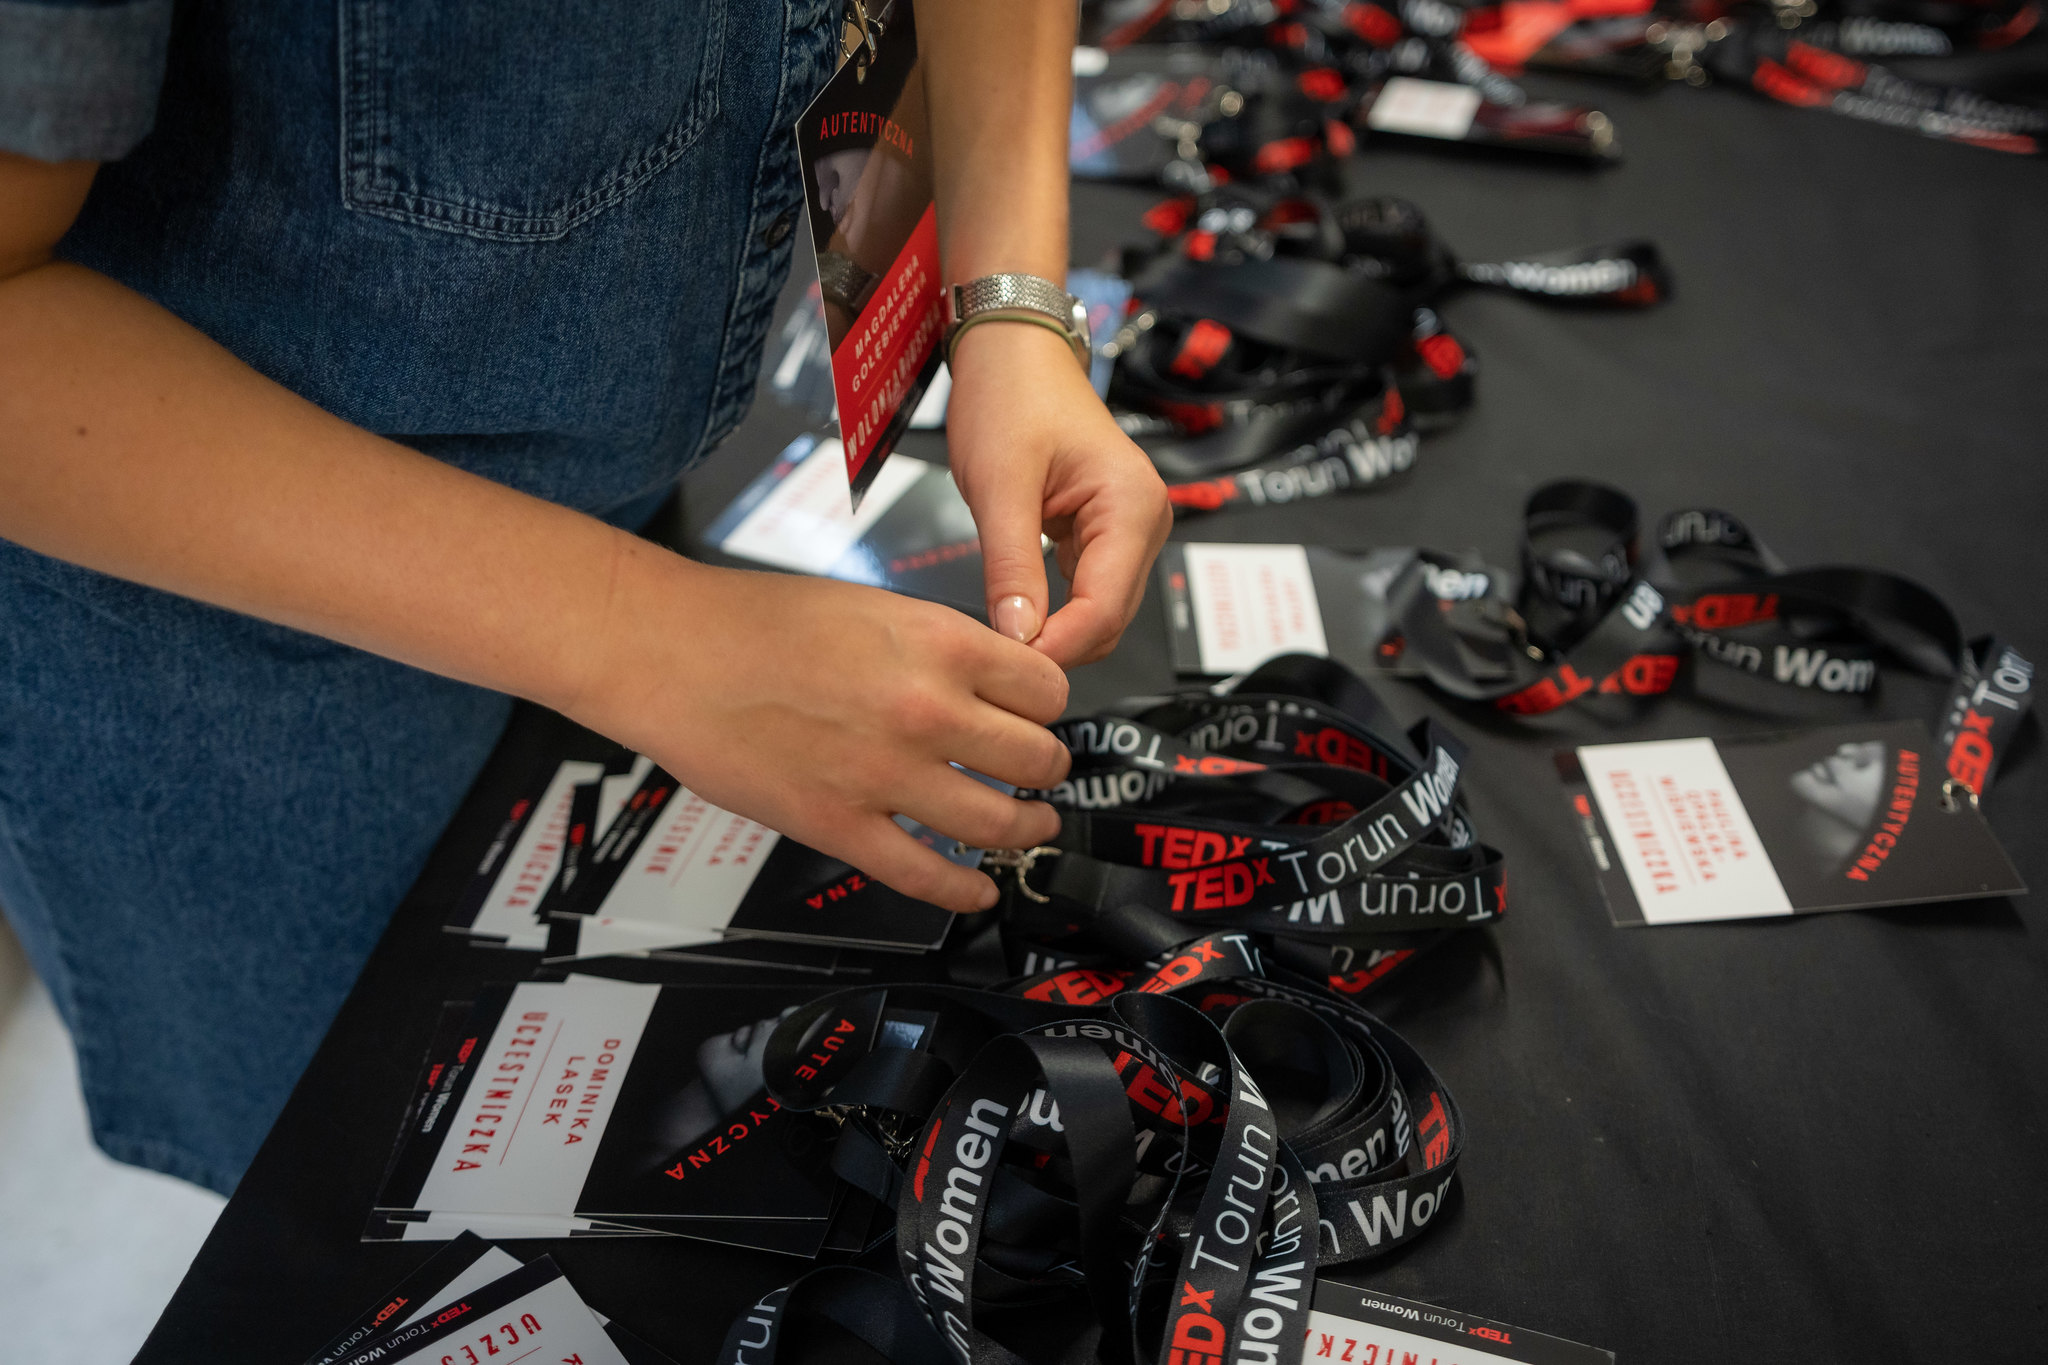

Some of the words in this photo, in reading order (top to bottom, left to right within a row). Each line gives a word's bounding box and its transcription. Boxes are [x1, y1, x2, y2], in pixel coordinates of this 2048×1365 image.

[820, 111, 914, 160] AUTENTYCZNA
[855, 255, 919, 359] MAGDALENA
[1134, 823, 1253, 870] TEDx
[1168, 857, 1277, 912] TEDx
[1278, 812, 1409, 895] Torun
[1359, 875, 1494, 922] Torun
[452, 1010, 549, 1173] UCZESTNICZKA
[541, 1055, 586, 1126] LASEK
[563, 1038, 622, 1146] DOMINIKA
[924, 1097, 1010, 1304] Women
[1190, 1123, 1271, 1272] Torun
[371, 1296, 409, 1329] TEDx
[430, 1302, 472, 1329] TEDx
[1361, 1297, 1420, 1321] Women
[1423, 1312, 1466, 1334] Torun
[332, 1325, 375, 1357] Torun
[386, 1323, 431, 1350] Torun
[1468, 1326, 1513, 1345] TEDx
